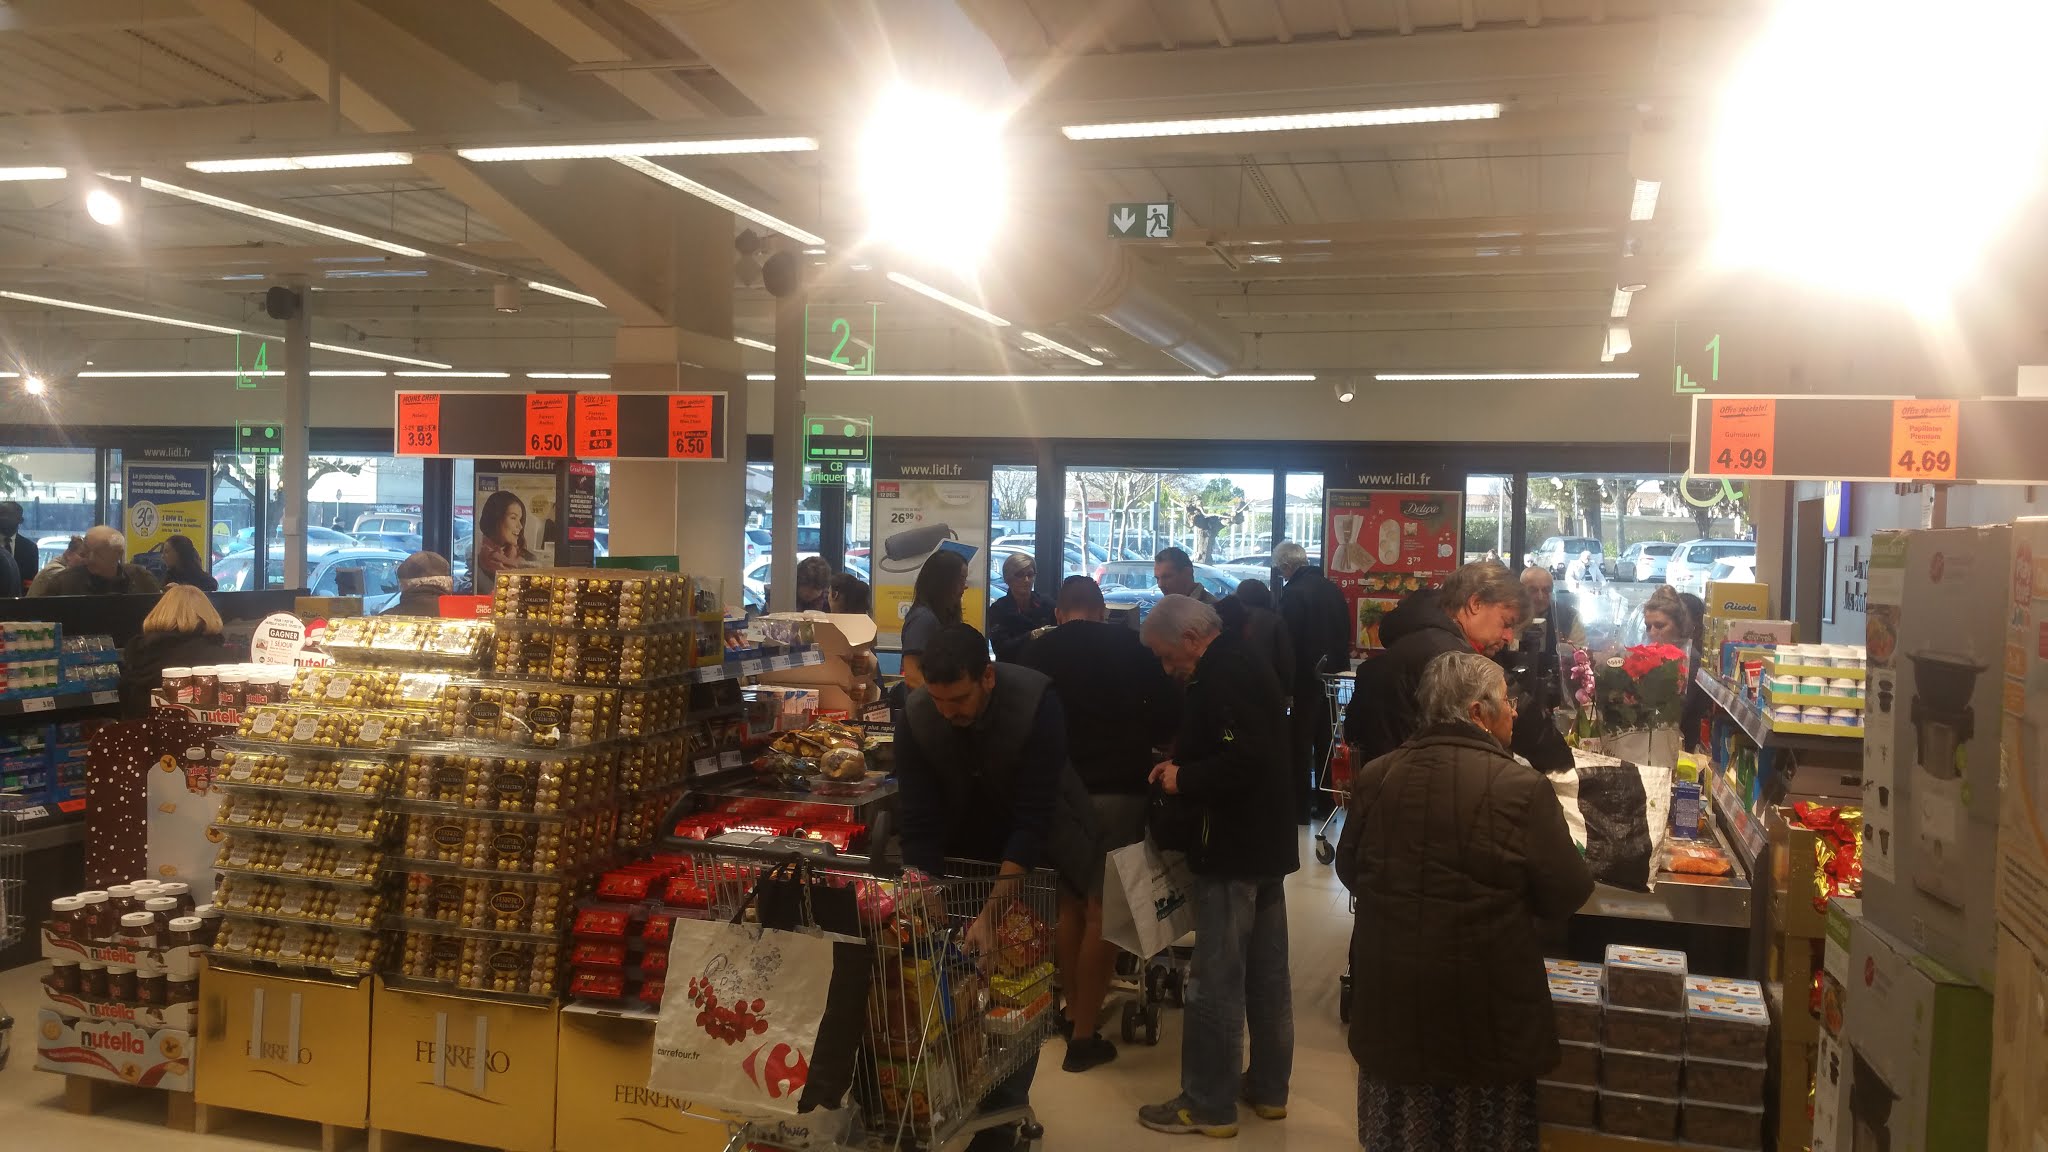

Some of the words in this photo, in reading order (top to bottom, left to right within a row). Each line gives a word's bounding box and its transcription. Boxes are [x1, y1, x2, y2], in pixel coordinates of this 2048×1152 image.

[831, 318, 850, 363] 2
[254, 341, 268, 379] 4
[1704, 334, 1720, 381] 1
[1719, 405, 1736, 414] Offre
[1901, 406, 1920, 414] Offre
[408, 432, 432, 447] 3.93
[531, 434, 562, 451] 6.50
[676, 438, 704, 454] 6.50
[144, 448, 191, 457] www.lidl.fr
[1717, 448, 1767, 470] 4.99
[256, 457, 266, 466] CB
[500, 459, 555, 471] www.lidl.fr
[830, 462, 843, 472] CB
[1898, 449, 1951, 473] 4.69
[901, 464, 962, 476] www.lidl.fr
[1358, 472, 1432, 486] www.lidl.fr
[1403, 502, 1440, 516] Deluxe
[1724, 601, 1758, 612] Ricola
[269, 629, 298, 640] GAGNER
[881, 725, 896, 733] rapid
[90, 946, 136, 964] nutella
[89, 1002, 135, 1021] nutella
[81, 1030, 144, 1055] nutella
[245, 1039, 312, 1065] FRREO
[657, 1046, 700, 1061] carrefour.fr
